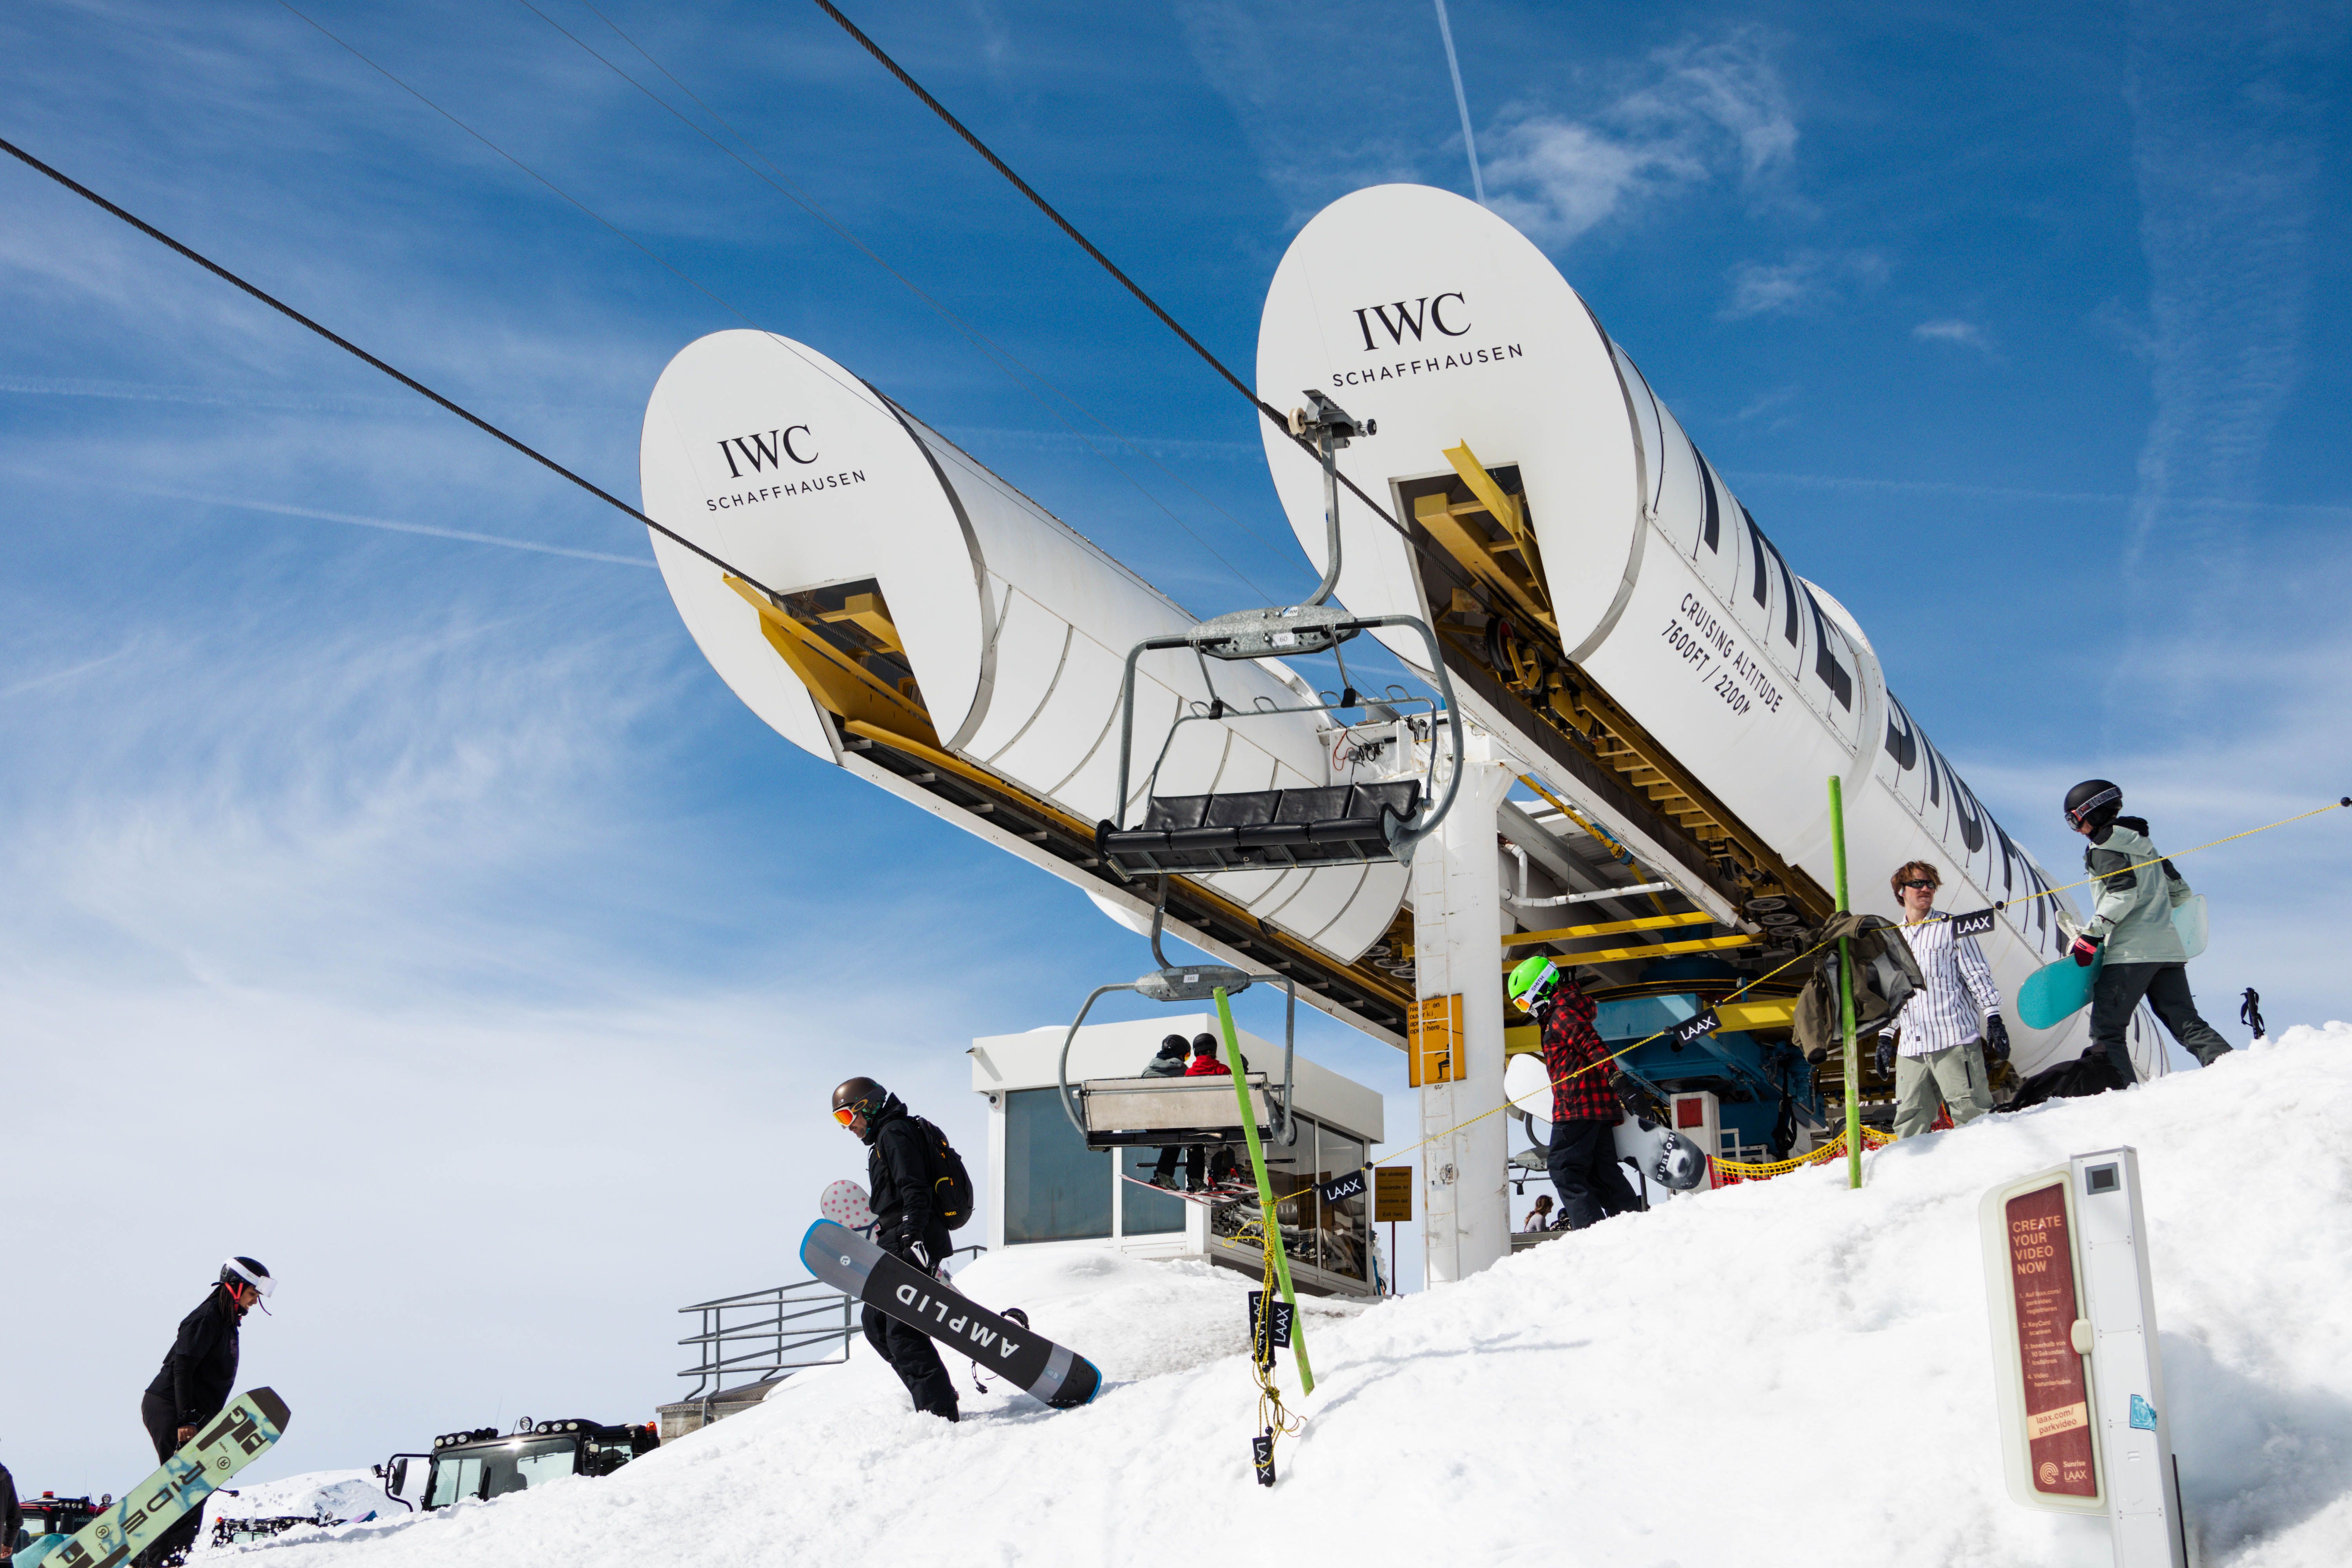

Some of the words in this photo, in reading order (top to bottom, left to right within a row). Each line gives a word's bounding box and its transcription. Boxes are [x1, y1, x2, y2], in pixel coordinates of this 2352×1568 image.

[1353, 292, 1471, 351] IWC
[1333, 344, 1523, 387] SCHAFFHAUSEN
[717, 424, 818, 478] IWC
[707, 470, 866, 511] SCHAFFHAUSEN
[1662, 619, 1710, 671] 7600FT
[1681, 593, 1734, 658] CRUISING
[1733, 651, 1783, 713] ALTITUDE
[1957, 916, 1990, 934] LAAX
[1531, 975, 1544, 991] SMITH
[1680, 1016, 1716, 1040] LAAX
[1657, 1134, 1675, 1180] BURTON
[1327, 1178, 1361, 1200] LAAX
[2013, 1215, 2062, 1233] CREATE
[2013, 1232, 2047, 1247] YOUR
[2014, 1245, 2053, 1261] VIDEO
[2017, 1260, 2047, 1275] NOW
[2025, 1298, 2052, 1307] parkvideo
[2026, 1306, 2057, 1315] registrieren
[896, 1284, 1020, 1358] AMPLID
[1274, 1308, 1289, 1342] LAAX
[2028, 1320, 2051, 1328] KeyCard
[2034, 1378, 2071, 1387] herunterladen
[2036, 1407, 2074, 1424] laax.com/
[2039, 1418, 2077, 1435] parkvideo
[218, 1441, 229, 1453] TWIN
[1257, 1443, 1270, 1479] LAAX
[2064, 1470, 2088, 1480] LAAX
[120, 1460, 207, 1535] RIDE
[98, 1543, 108, 1554] TWIN
